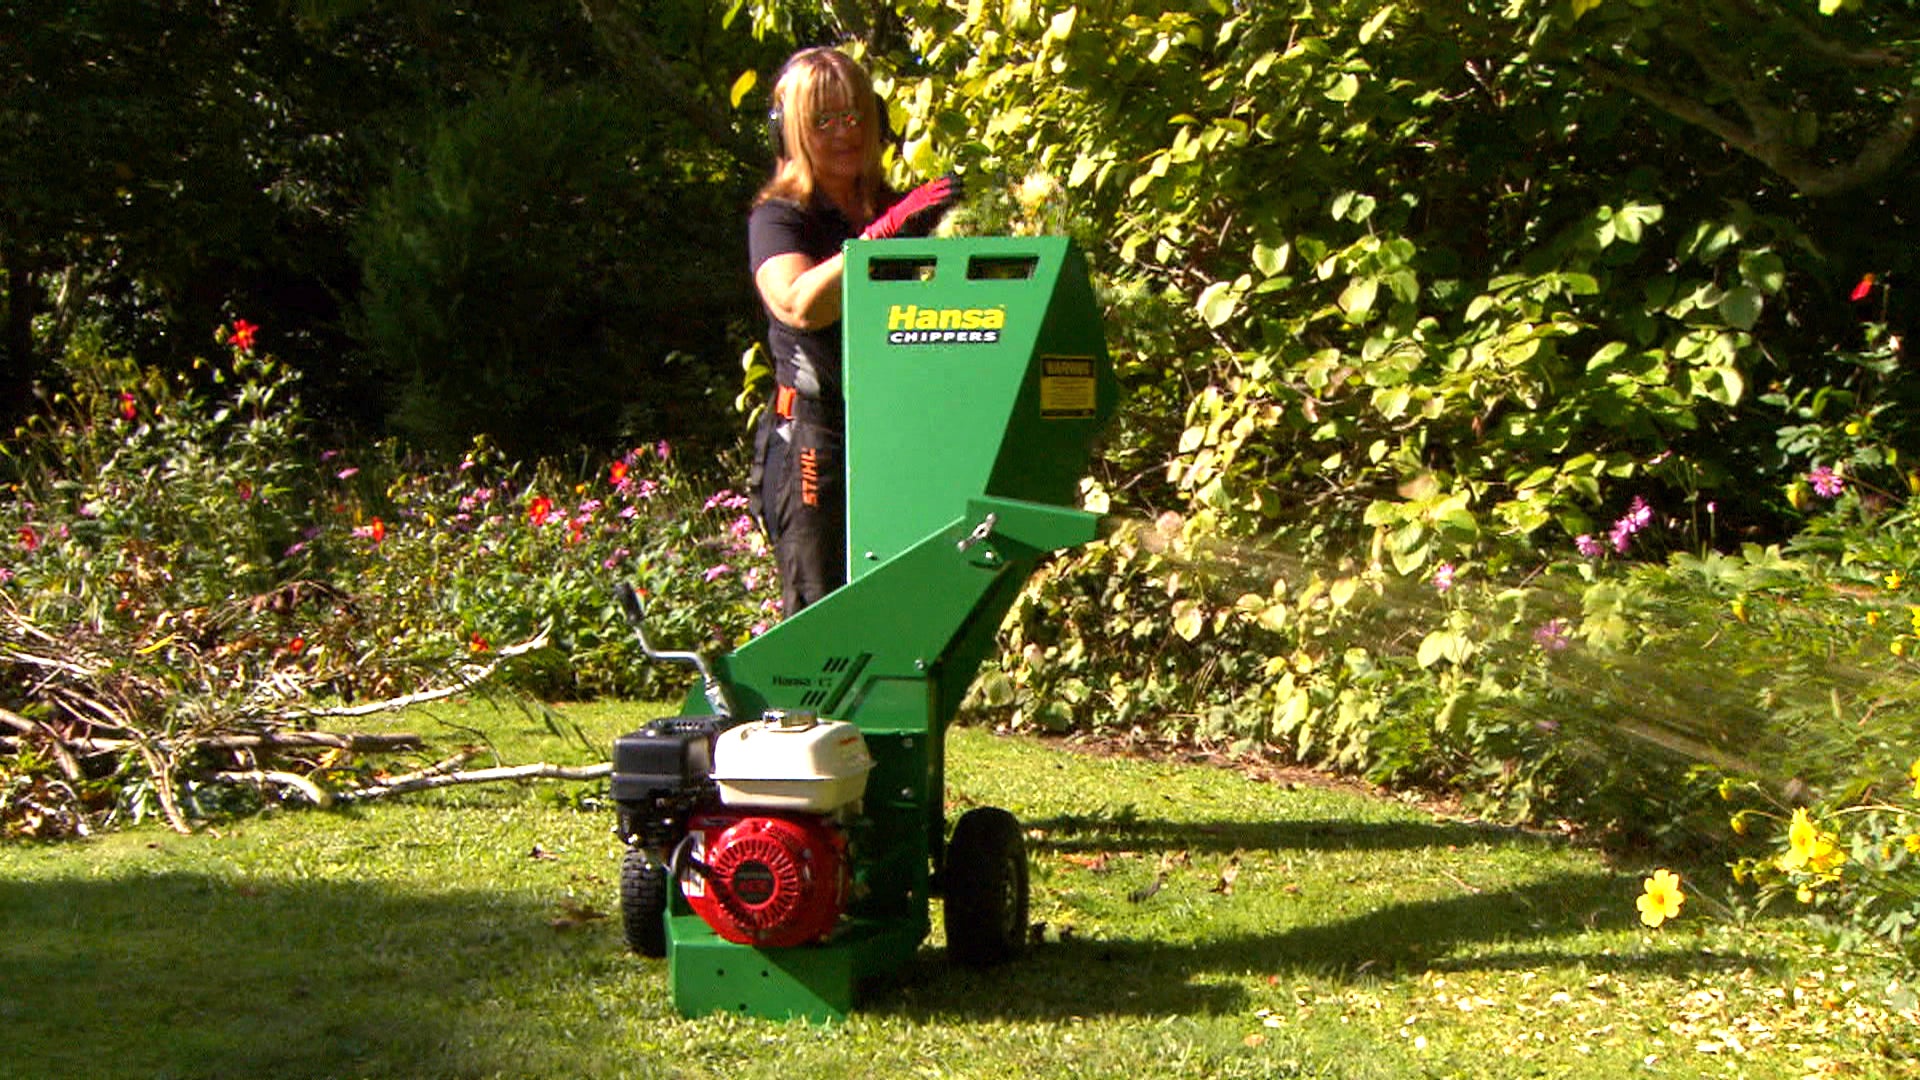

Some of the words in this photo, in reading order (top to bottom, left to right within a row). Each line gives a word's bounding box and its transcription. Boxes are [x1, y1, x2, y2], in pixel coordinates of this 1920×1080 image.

[888, 304, 1005, 330] Hansa
[889, 331, 998, 343] CHIPPERS
[800, 447, 818, 506] STIHL
